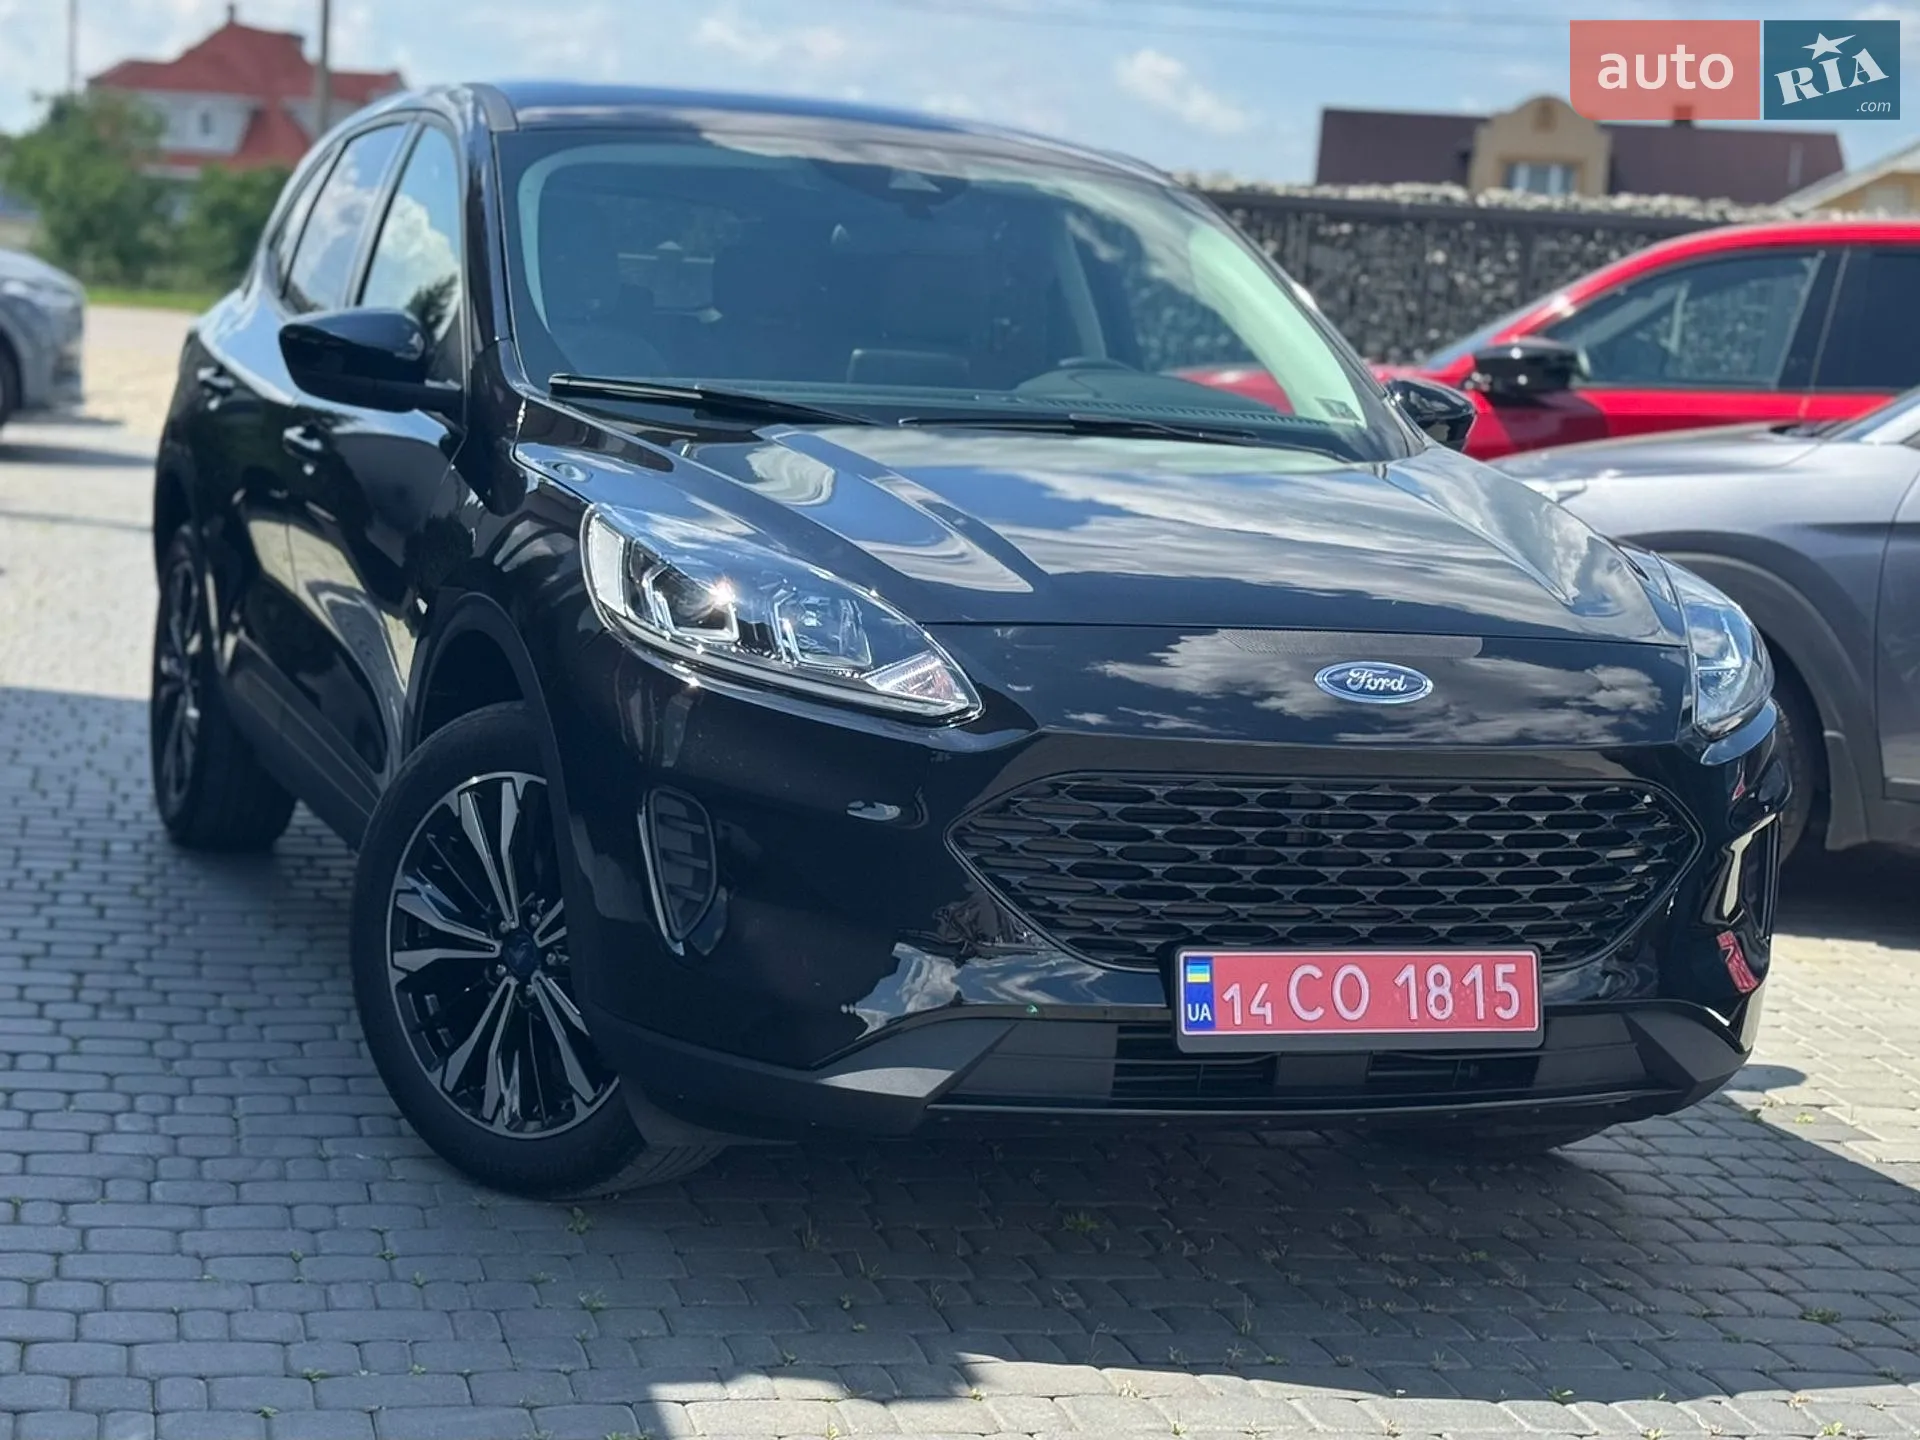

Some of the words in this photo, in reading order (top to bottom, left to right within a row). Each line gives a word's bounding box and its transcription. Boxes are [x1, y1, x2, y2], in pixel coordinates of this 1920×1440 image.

[1346, 667, 1408, 692] Ford
[1221, 982, 1273, 1025] 14
[1287, 963, 1370, 1022] CO
[1394, 963, 1520, 1020] 1815
[1187, 1003, 1212, 1022] UA
